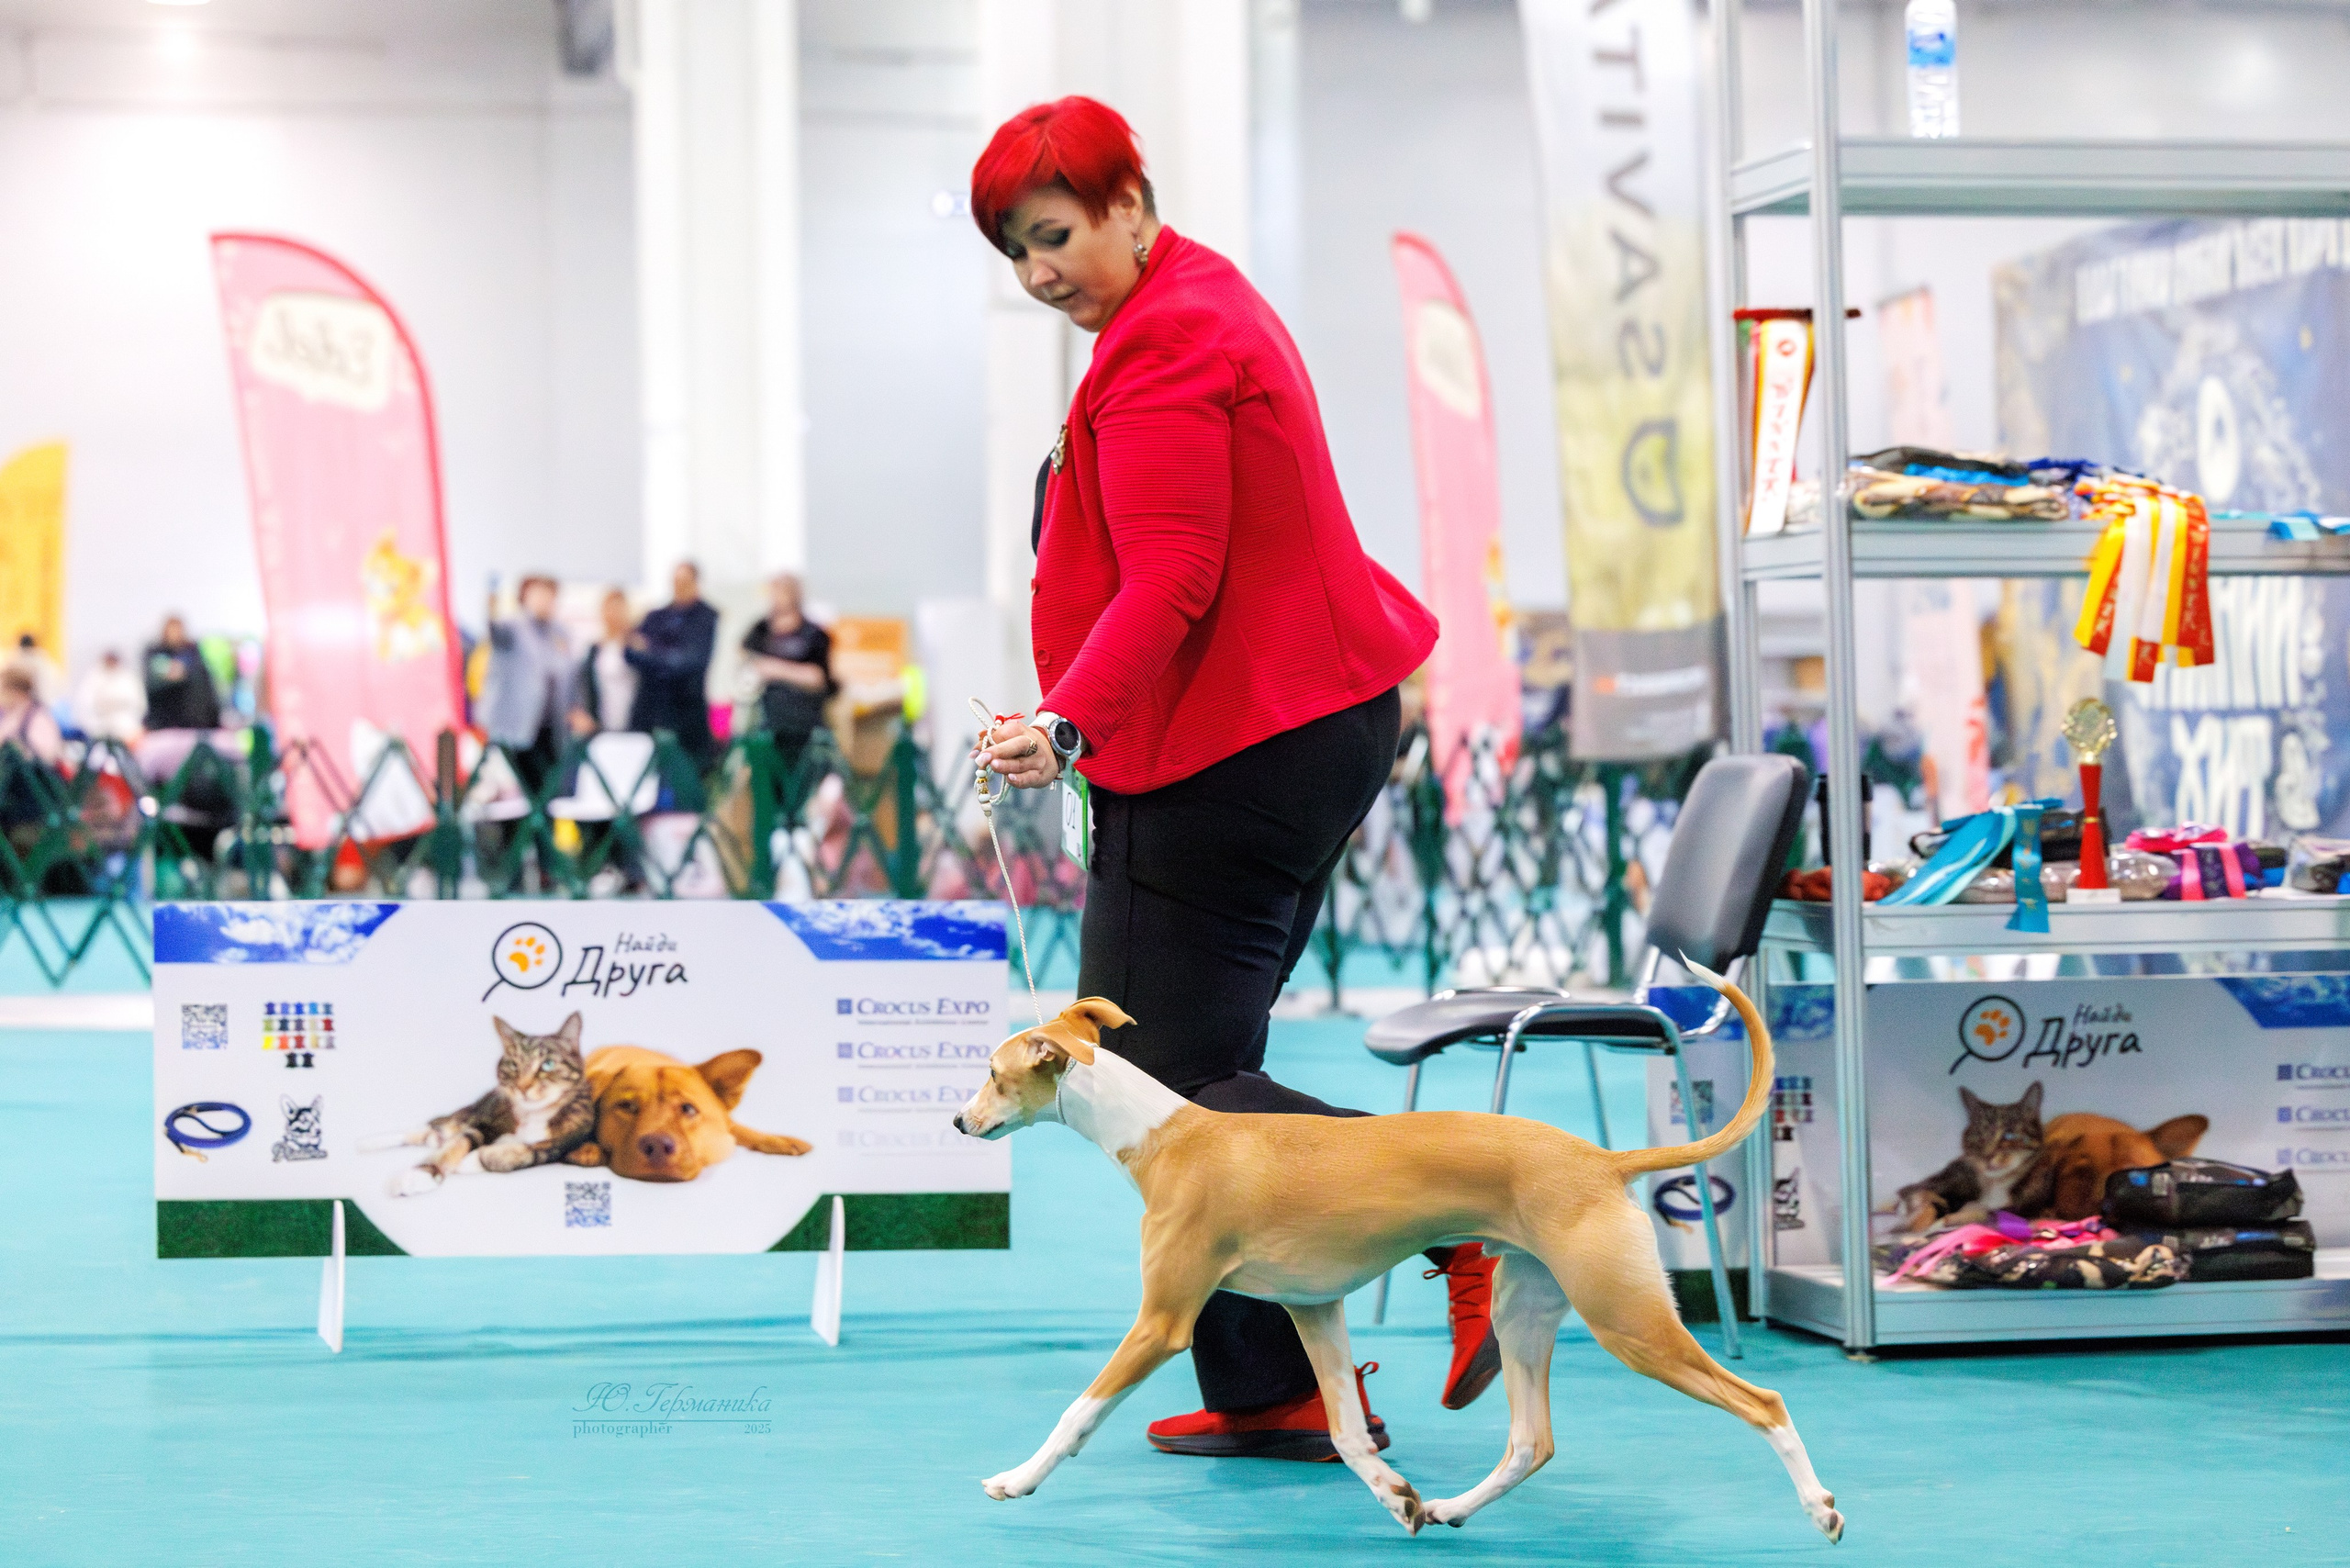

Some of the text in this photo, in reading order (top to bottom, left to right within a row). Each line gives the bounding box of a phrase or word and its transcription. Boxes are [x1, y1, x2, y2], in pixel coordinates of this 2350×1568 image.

[614, 932, 677, 954] Найди
[561, 945, 688, 998] Друга
[2021, 1015, 2143, 1069] Друга
